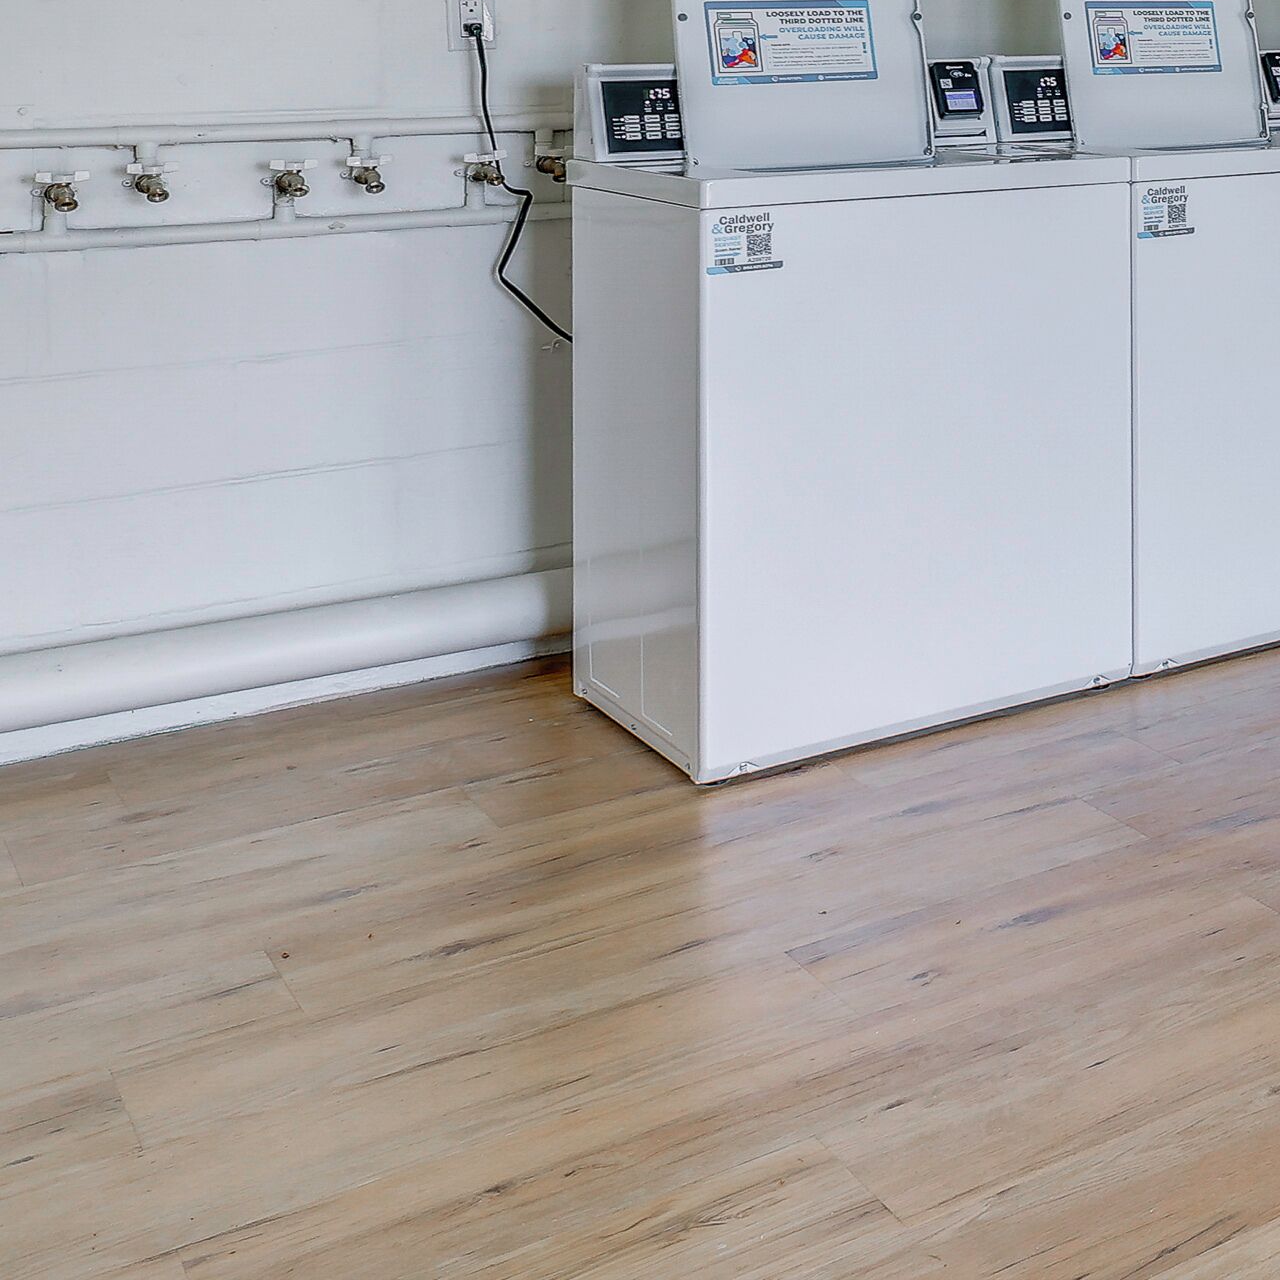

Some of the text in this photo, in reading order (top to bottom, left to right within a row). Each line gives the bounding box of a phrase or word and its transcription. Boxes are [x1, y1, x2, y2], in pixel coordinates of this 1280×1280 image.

[1147, 186, 1186, 196] Caldwell
[1151, 195, 1189, 204] Gregory
[719, 212, 770, 225] Caldwell
[724, 222, 774, 234] Gregory
